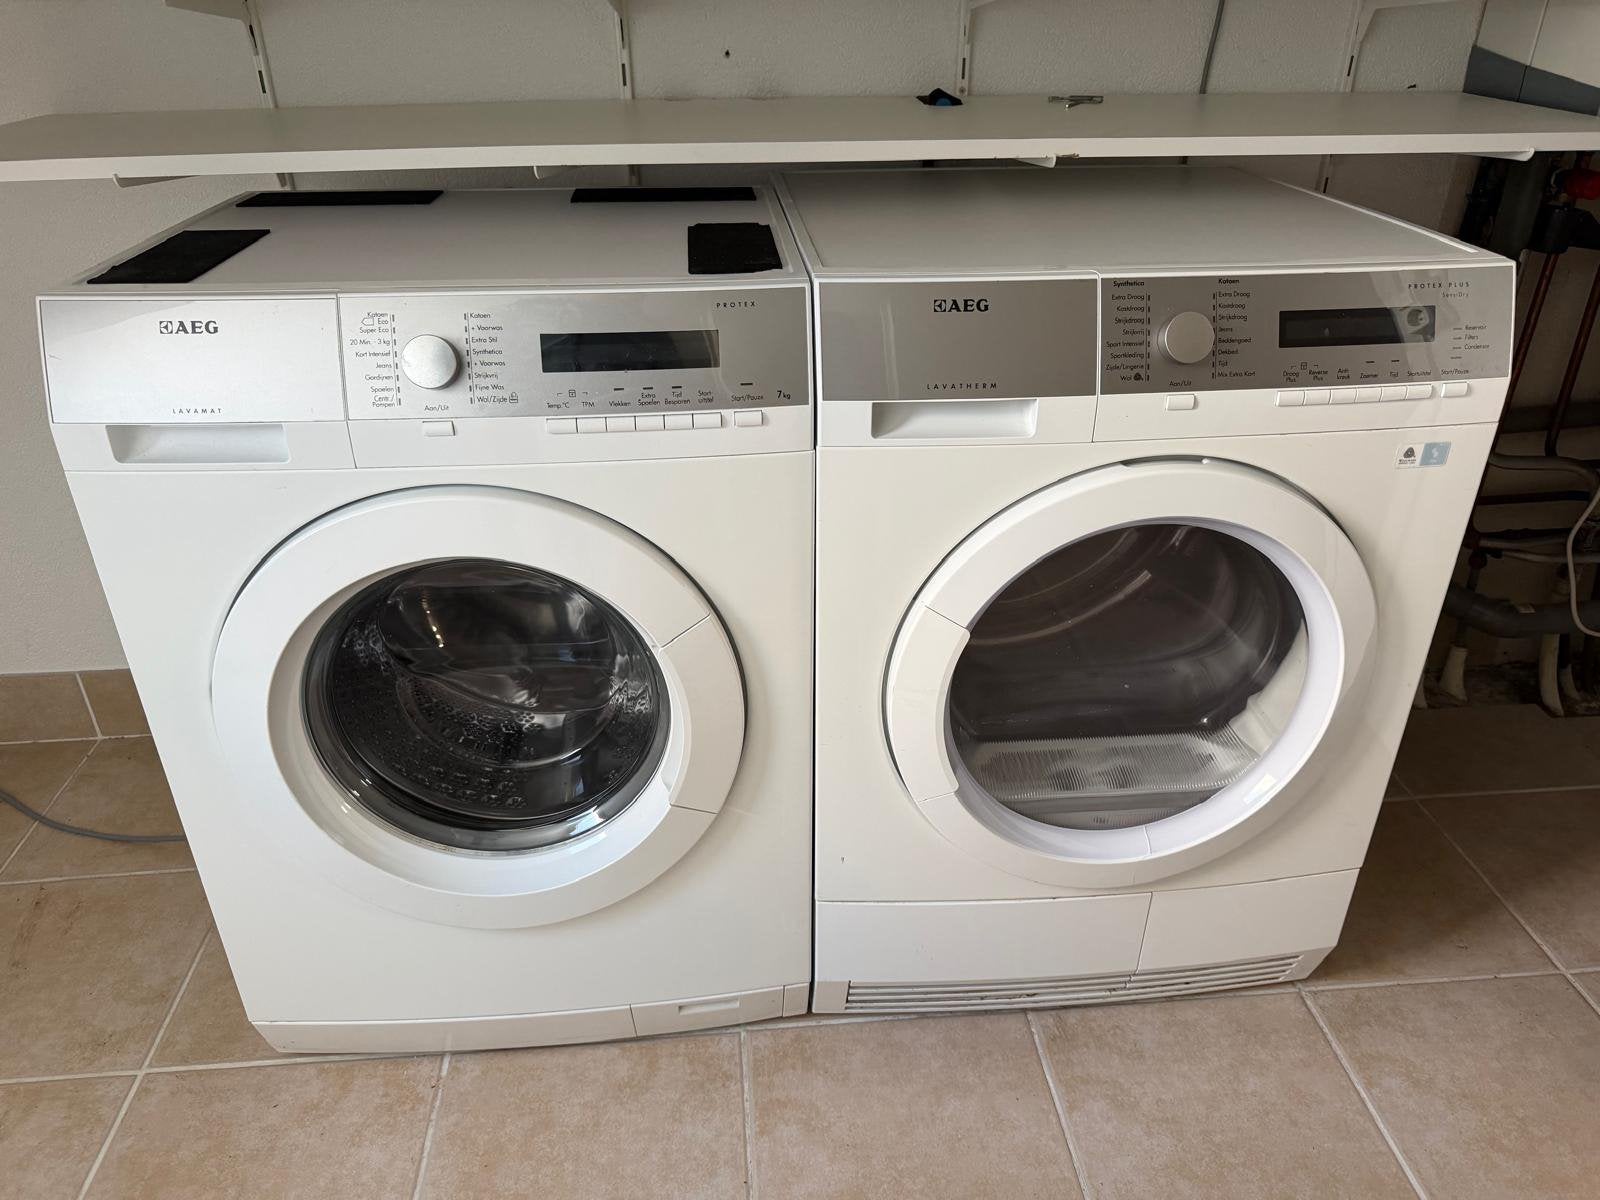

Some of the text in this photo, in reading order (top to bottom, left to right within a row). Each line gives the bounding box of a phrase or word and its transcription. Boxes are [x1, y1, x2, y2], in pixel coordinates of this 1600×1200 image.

[948, 299, 989, 312] AEG
[175, 321, 218, 334] AEG
[777, 390, 782, 399] 7
